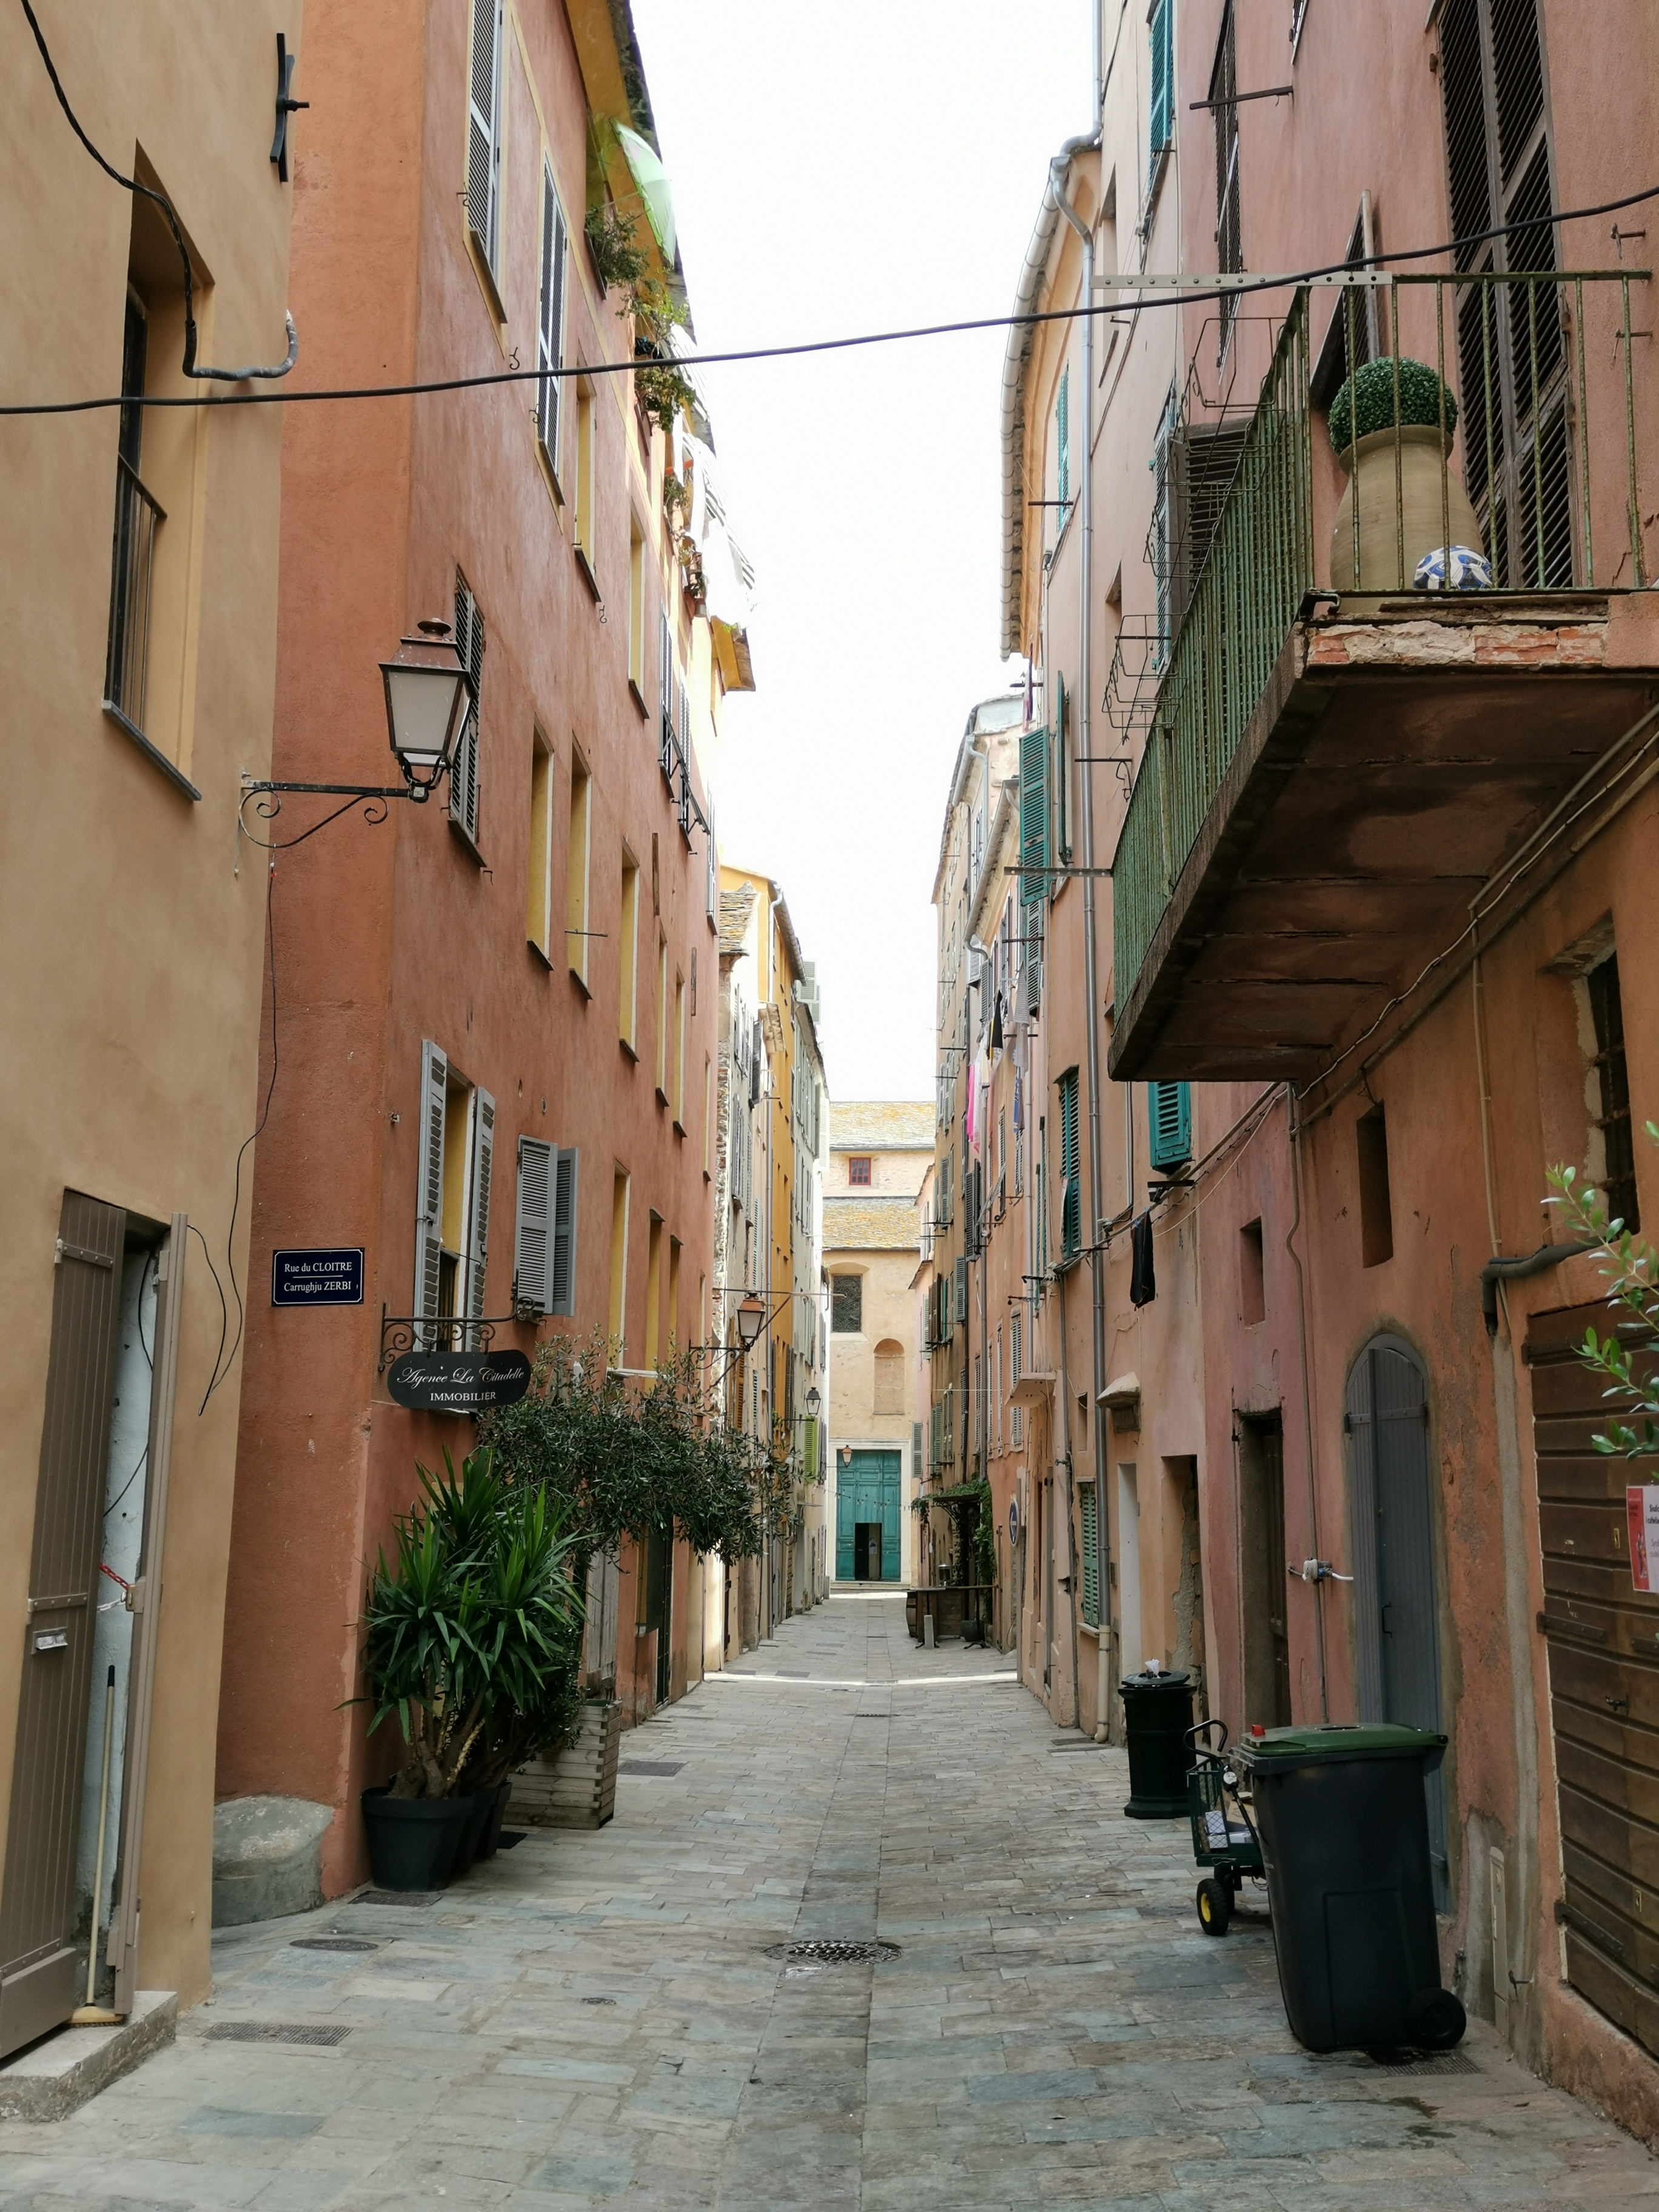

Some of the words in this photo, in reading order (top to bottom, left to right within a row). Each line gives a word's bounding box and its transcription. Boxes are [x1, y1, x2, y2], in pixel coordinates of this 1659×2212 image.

[284, 1264, 300, 1272] Rue
[301, 1263, 311, 1272] du
[312, 1262, 352, 1272] CLOITRE
[284, 1282, 322, 1293] Carrughju
[324, 1281, 352, 1290] ZERBI
[397, 1367, 448, 1389] Agence
[450, 1367, 475, 1384] La
[478, 1367, 525, 1383] Citadelle
[430, 1392, 496, 1401] IMMOBILIER
